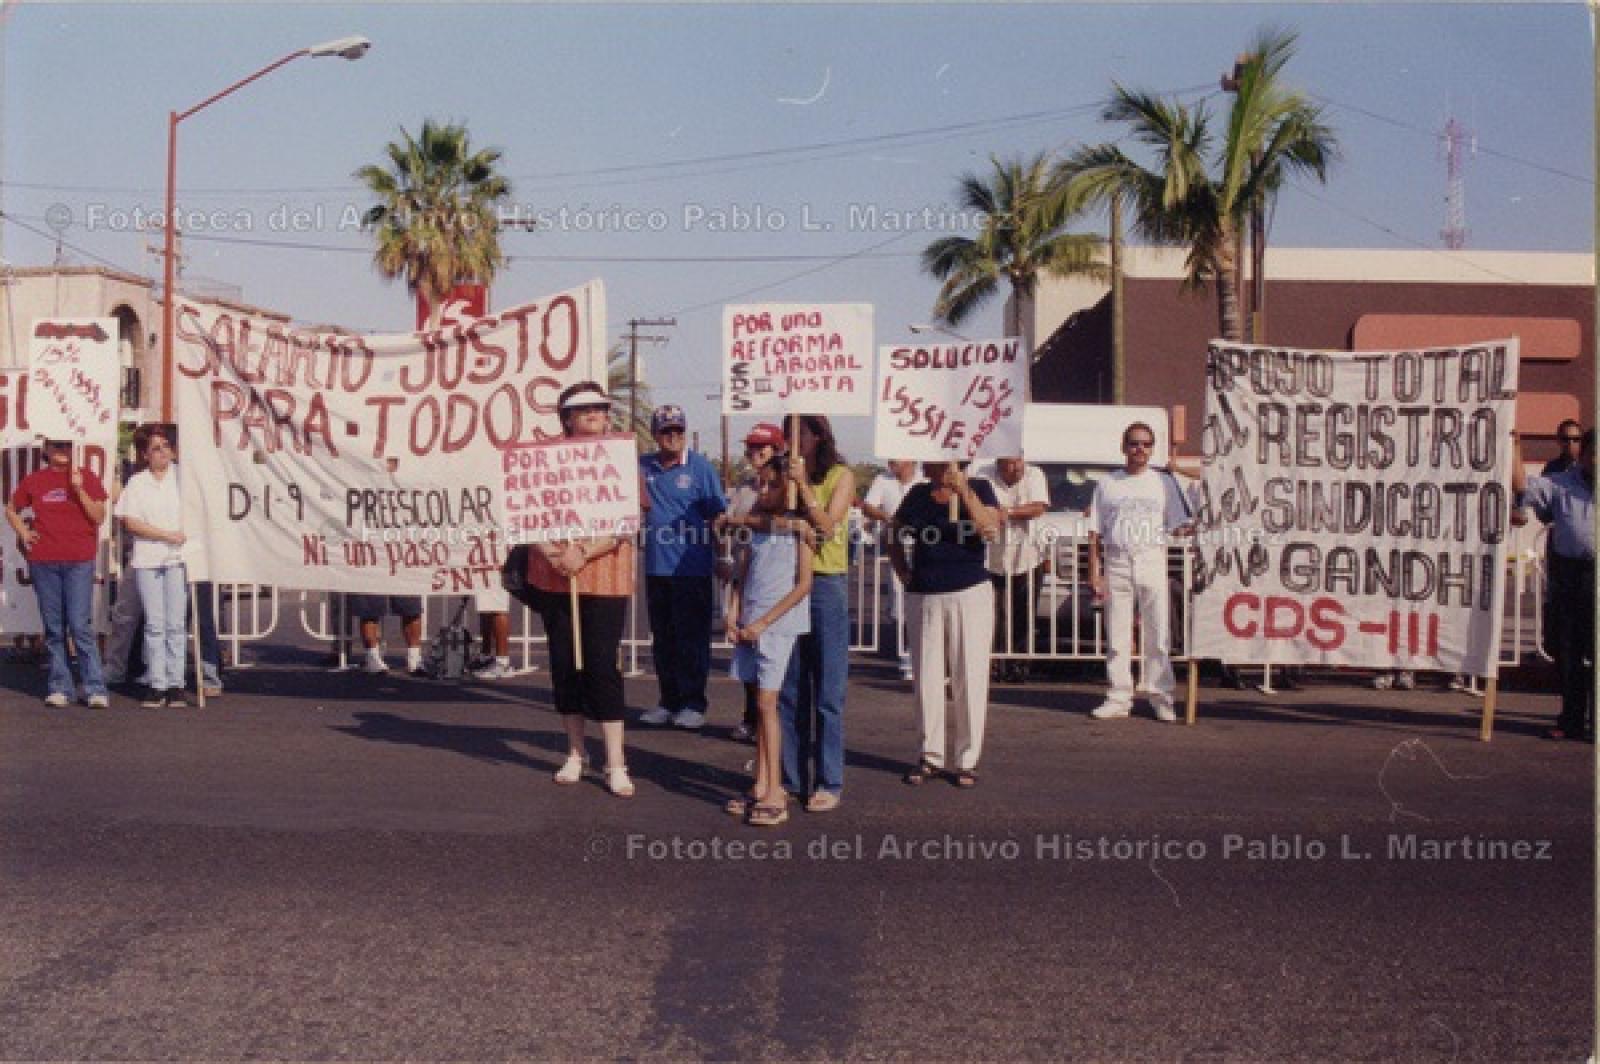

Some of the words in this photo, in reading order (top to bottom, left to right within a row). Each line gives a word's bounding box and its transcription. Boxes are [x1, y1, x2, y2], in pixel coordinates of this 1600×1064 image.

[733, 311, 773, 339] POR
[400, 295, 580, 392] JUSTO
[731, 333, 843, 361] REFORMA
[890, 341, 1019, 370] SOLUCION
[764, 354, 862, 376] LABORAL
[1353, 345, 1517, 403] TOTAL
[210, 380, 340, 458] PARA
[365, 376, 563, 457] TODOS
[1255, 401, 1498, 472] REGISTRO
[504, 447, 549, 473] POR
[556, 442, 611, 465] UNA
[504, 463, 622, 492] REFORMA
[346, 485, 498, 529] PREESCOLAR
[506, 484, 629, 512] LABORAL
[1260, 476, 1508, 545] SINDICATO
[303, 535, 329, 566] Ni
[343, 540, 377, 568] un
[383, 538, 449, 577] paso
[432, 566, 503, 593] SNT
[1279, 541, 1495, 611] GANDHI
